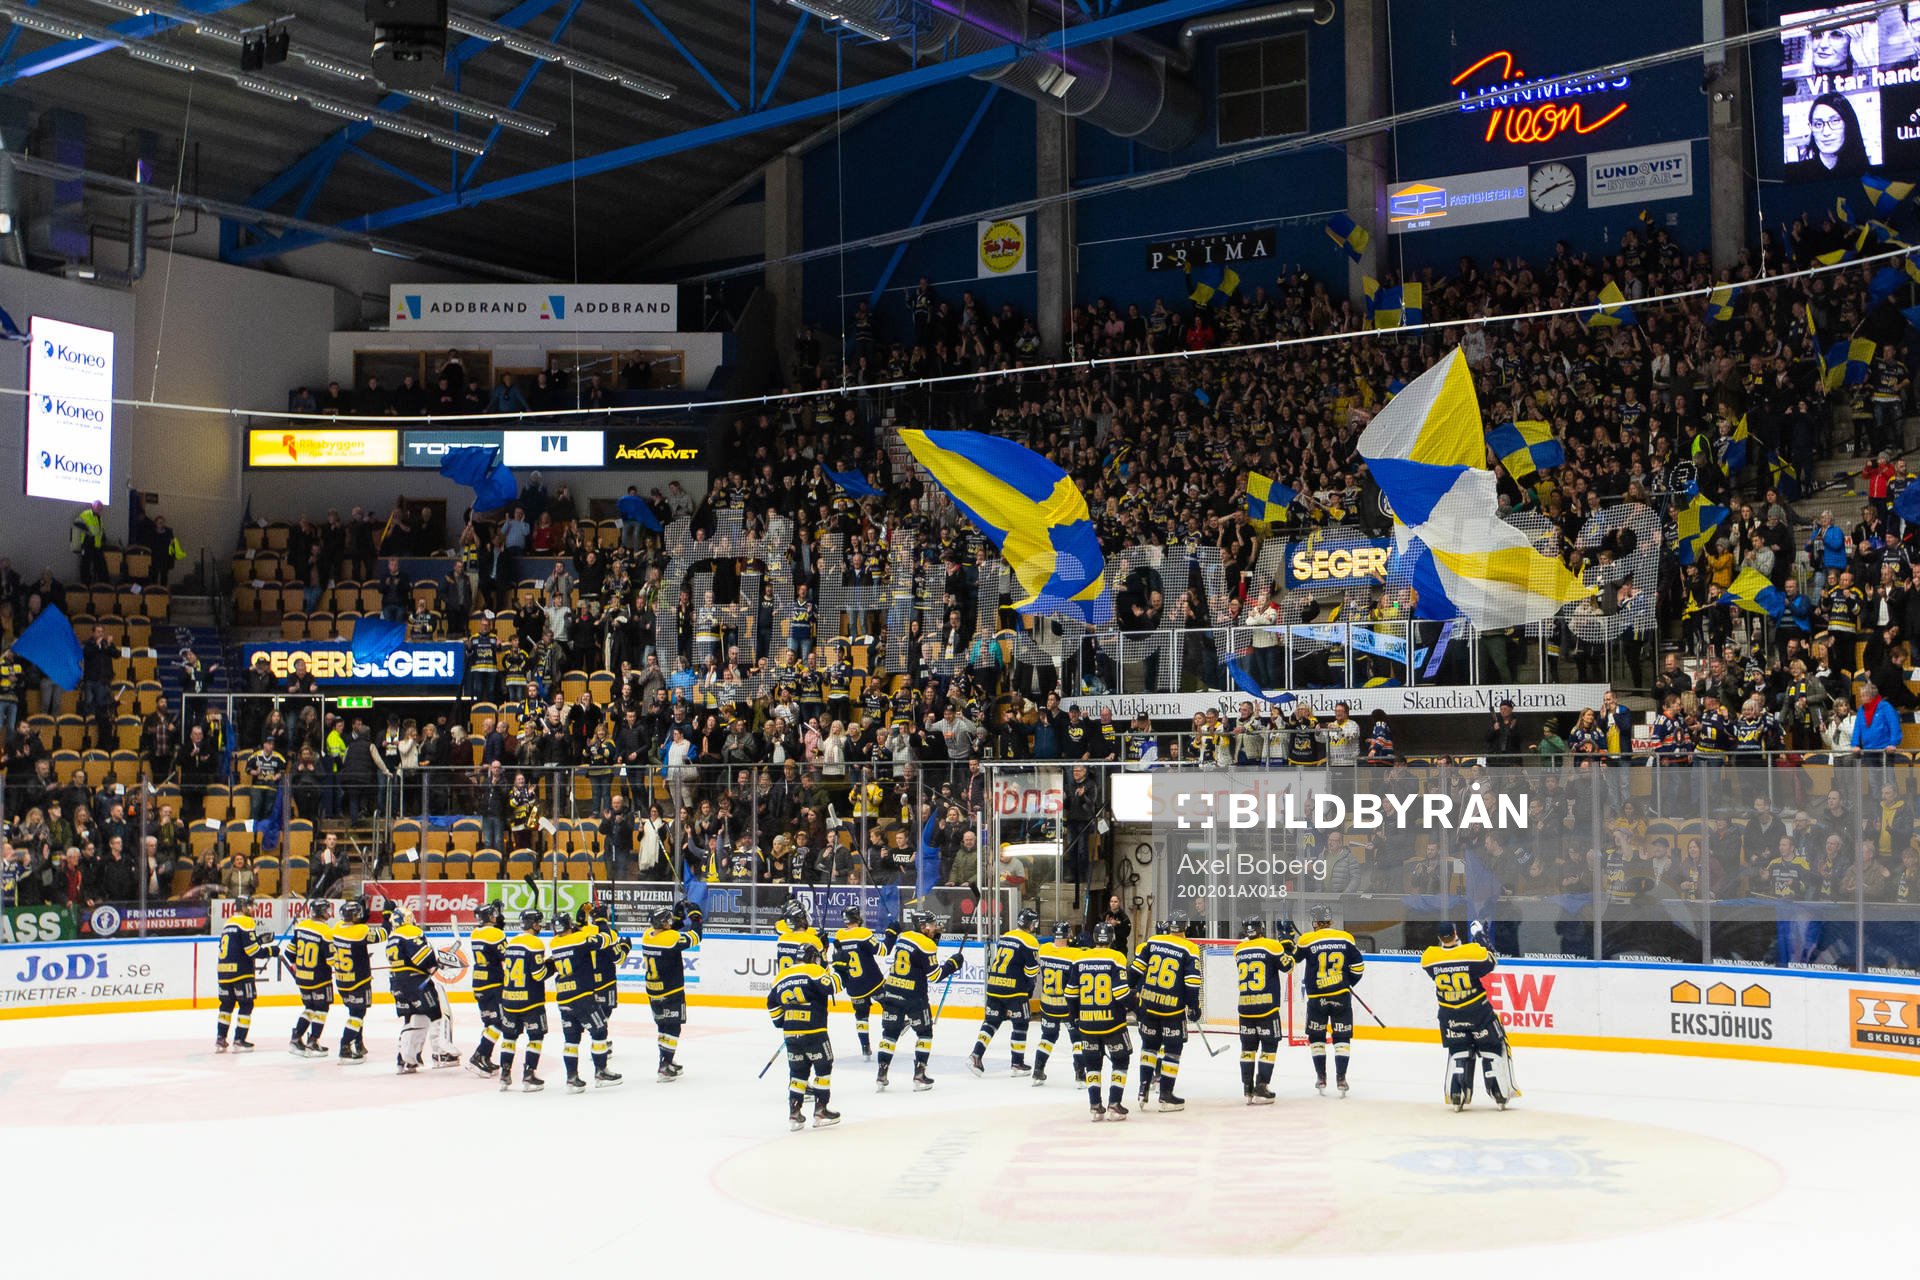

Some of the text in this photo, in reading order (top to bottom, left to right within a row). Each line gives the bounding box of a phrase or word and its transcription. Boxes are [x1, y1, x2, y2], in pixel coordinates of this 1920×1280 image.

[1807, 75, 1829, 95] Vi
[1834, 75, 1866, 92] tar
[1596, 158, 1682, 180] LUNDQVIST
[1607, 173, 1673, 191] BYGG AB
[1450, 190, 1511, 207] FASTIGHETER
[1512, 185, 1526, 198] AB
[1151, 239, 1268, 270] PRIMA
[431, 302, 527, 313] ADDBRAND
[574, 302, 670, 313] ADDBRAND
[58, 344, 106, 369] Koneo
[56, 399, 104, 423] Koneo
[54, 454, 103, 477] Koneo
[1403, 689, 1567, 710] SkandiaMäklarna
[892, 854, 911, 862] VANS
[634, 890, 673, 901] PIZZERIA
[127, 918, 198, 929] KYINDUSTRI
[1379, 948, 1425, 956] KONRADSSON
[1524, 952, 1575, 960] KONRADSSONS
[1619, 954, 1672, 963] KONRADSSONS
[16, 953, 151, 983] JoDi .se
[1145, 954, 1180, 989] 26
[1316, 952, 1345, 978] 13
[1713, 958, 1764, 967] KONRADSSONS
[1788, 962, 1838, 971] KONRADSSONS
[1867, 966, 1916, 976] KONRADSSONS
[1043, 967, 1064, 996] 21
[1238, 960, 1266, 991] 23
[0, 986, 78, 1001] TIKETTER
[91, 982, 164, 998] DEKALER
[1080, 972, 1113, 1006] 28
[1480, 972, 1556, 1012] EW
[1501, 1012, 1554, 1028] DRIVE
[1671, 1010, 1773, 1040] EKSJÖHUS
